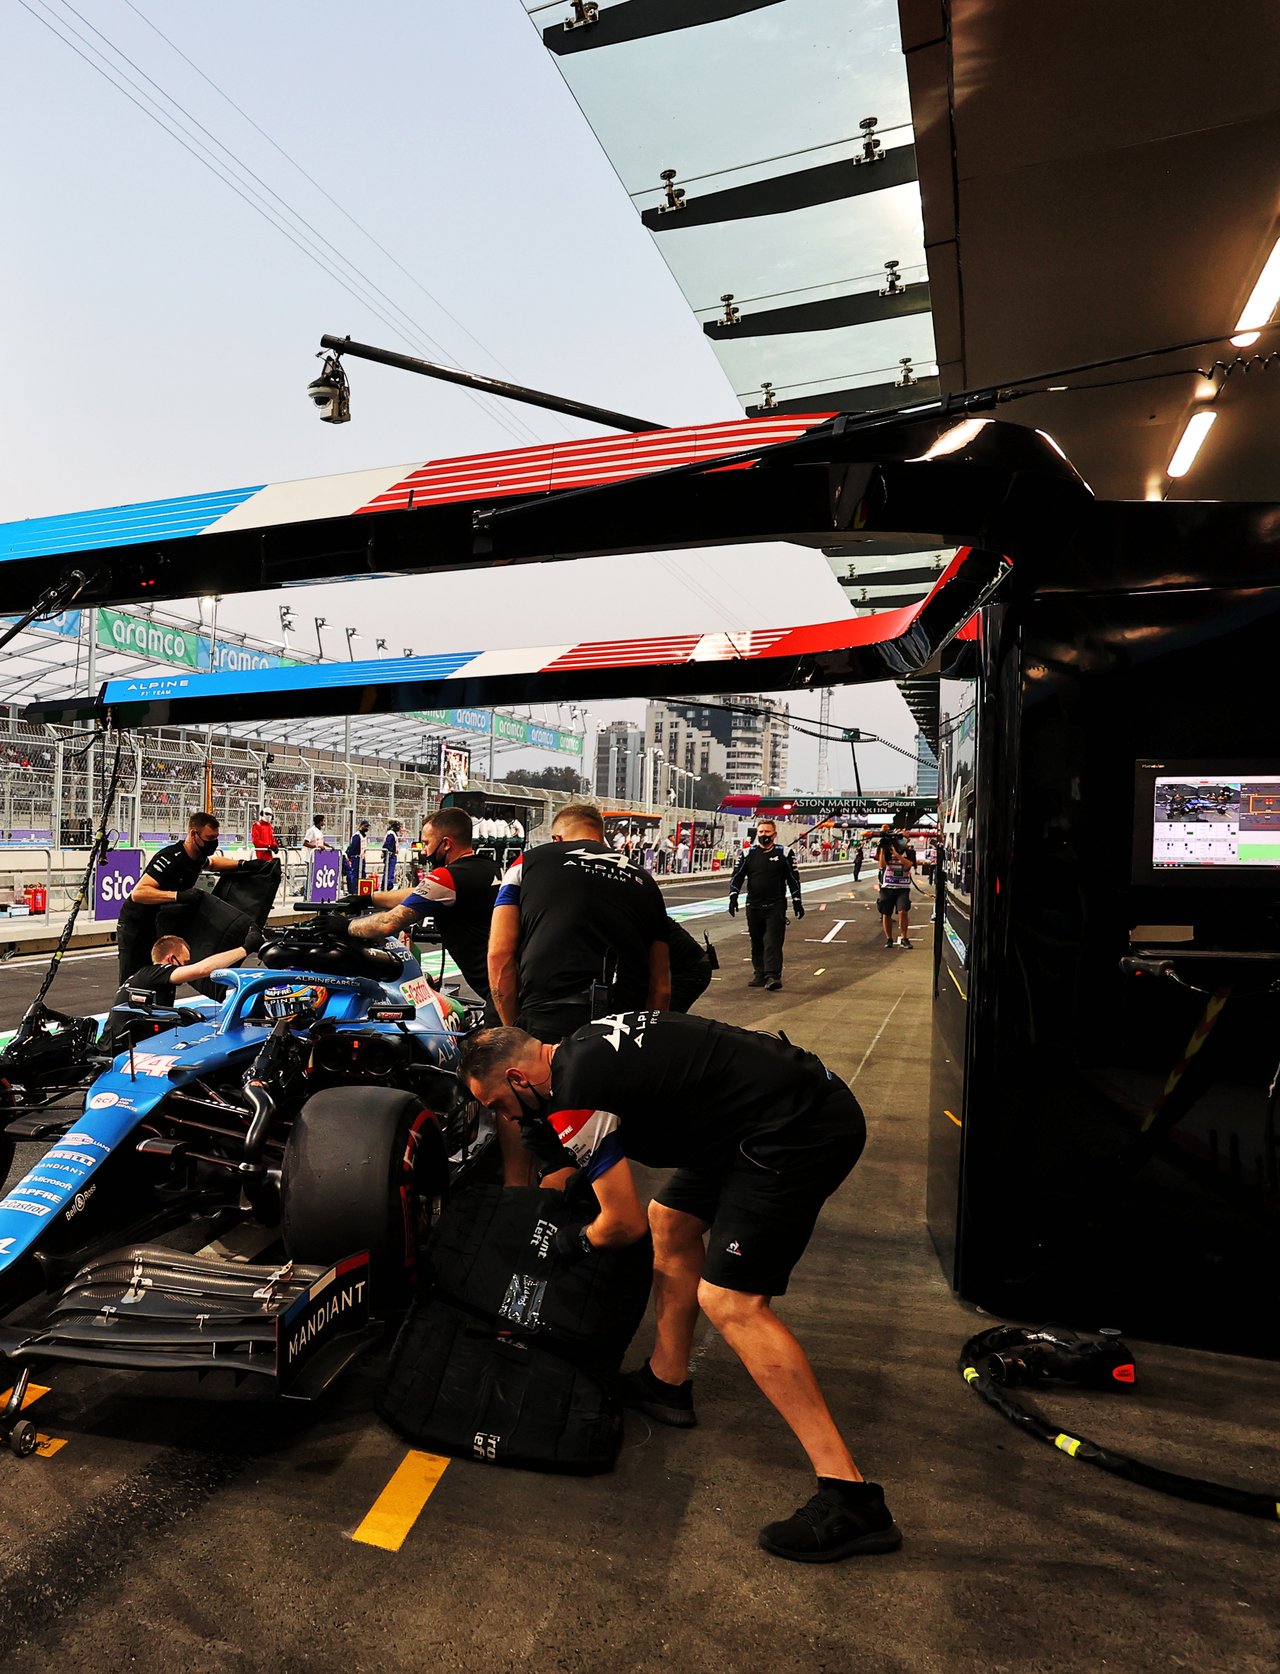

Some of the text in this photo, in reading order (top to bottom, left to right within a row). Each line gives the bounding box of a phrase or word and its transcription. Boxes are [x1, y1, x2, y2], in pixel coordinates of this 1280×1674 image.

[112, 619, 185, 657] aramco
[127, 680, 189, 691] ALPINE
[456, 708, 486, 729] aramco
[498, 718, 524, 739] aramco
[531, 728, 554, 746] aramco
[559, 735, 579, 752] aramco
[792, 799, 916, 808] ASTON MARTIN Cognizant
[315, 864, 336, 889] stc
[563, 859, 643, 885] ALPINE
[602, 872, 626, 882] TEAM
[101, 870, 135, 901] stc
[634, 1010, 649, 1048] ALPI
[33, 1175, 73, 1191] Microsoft
[7, 1201, 46, 1215] Castrol
[65, 1205, 79, 1221] Bell
[83, 1184, 97, 1200] Ross
[530, 1219, 548, 1246] Left
[538, 1222, 558, 1259] Front
[288, 1280, 366, 1364] MANDIANT
